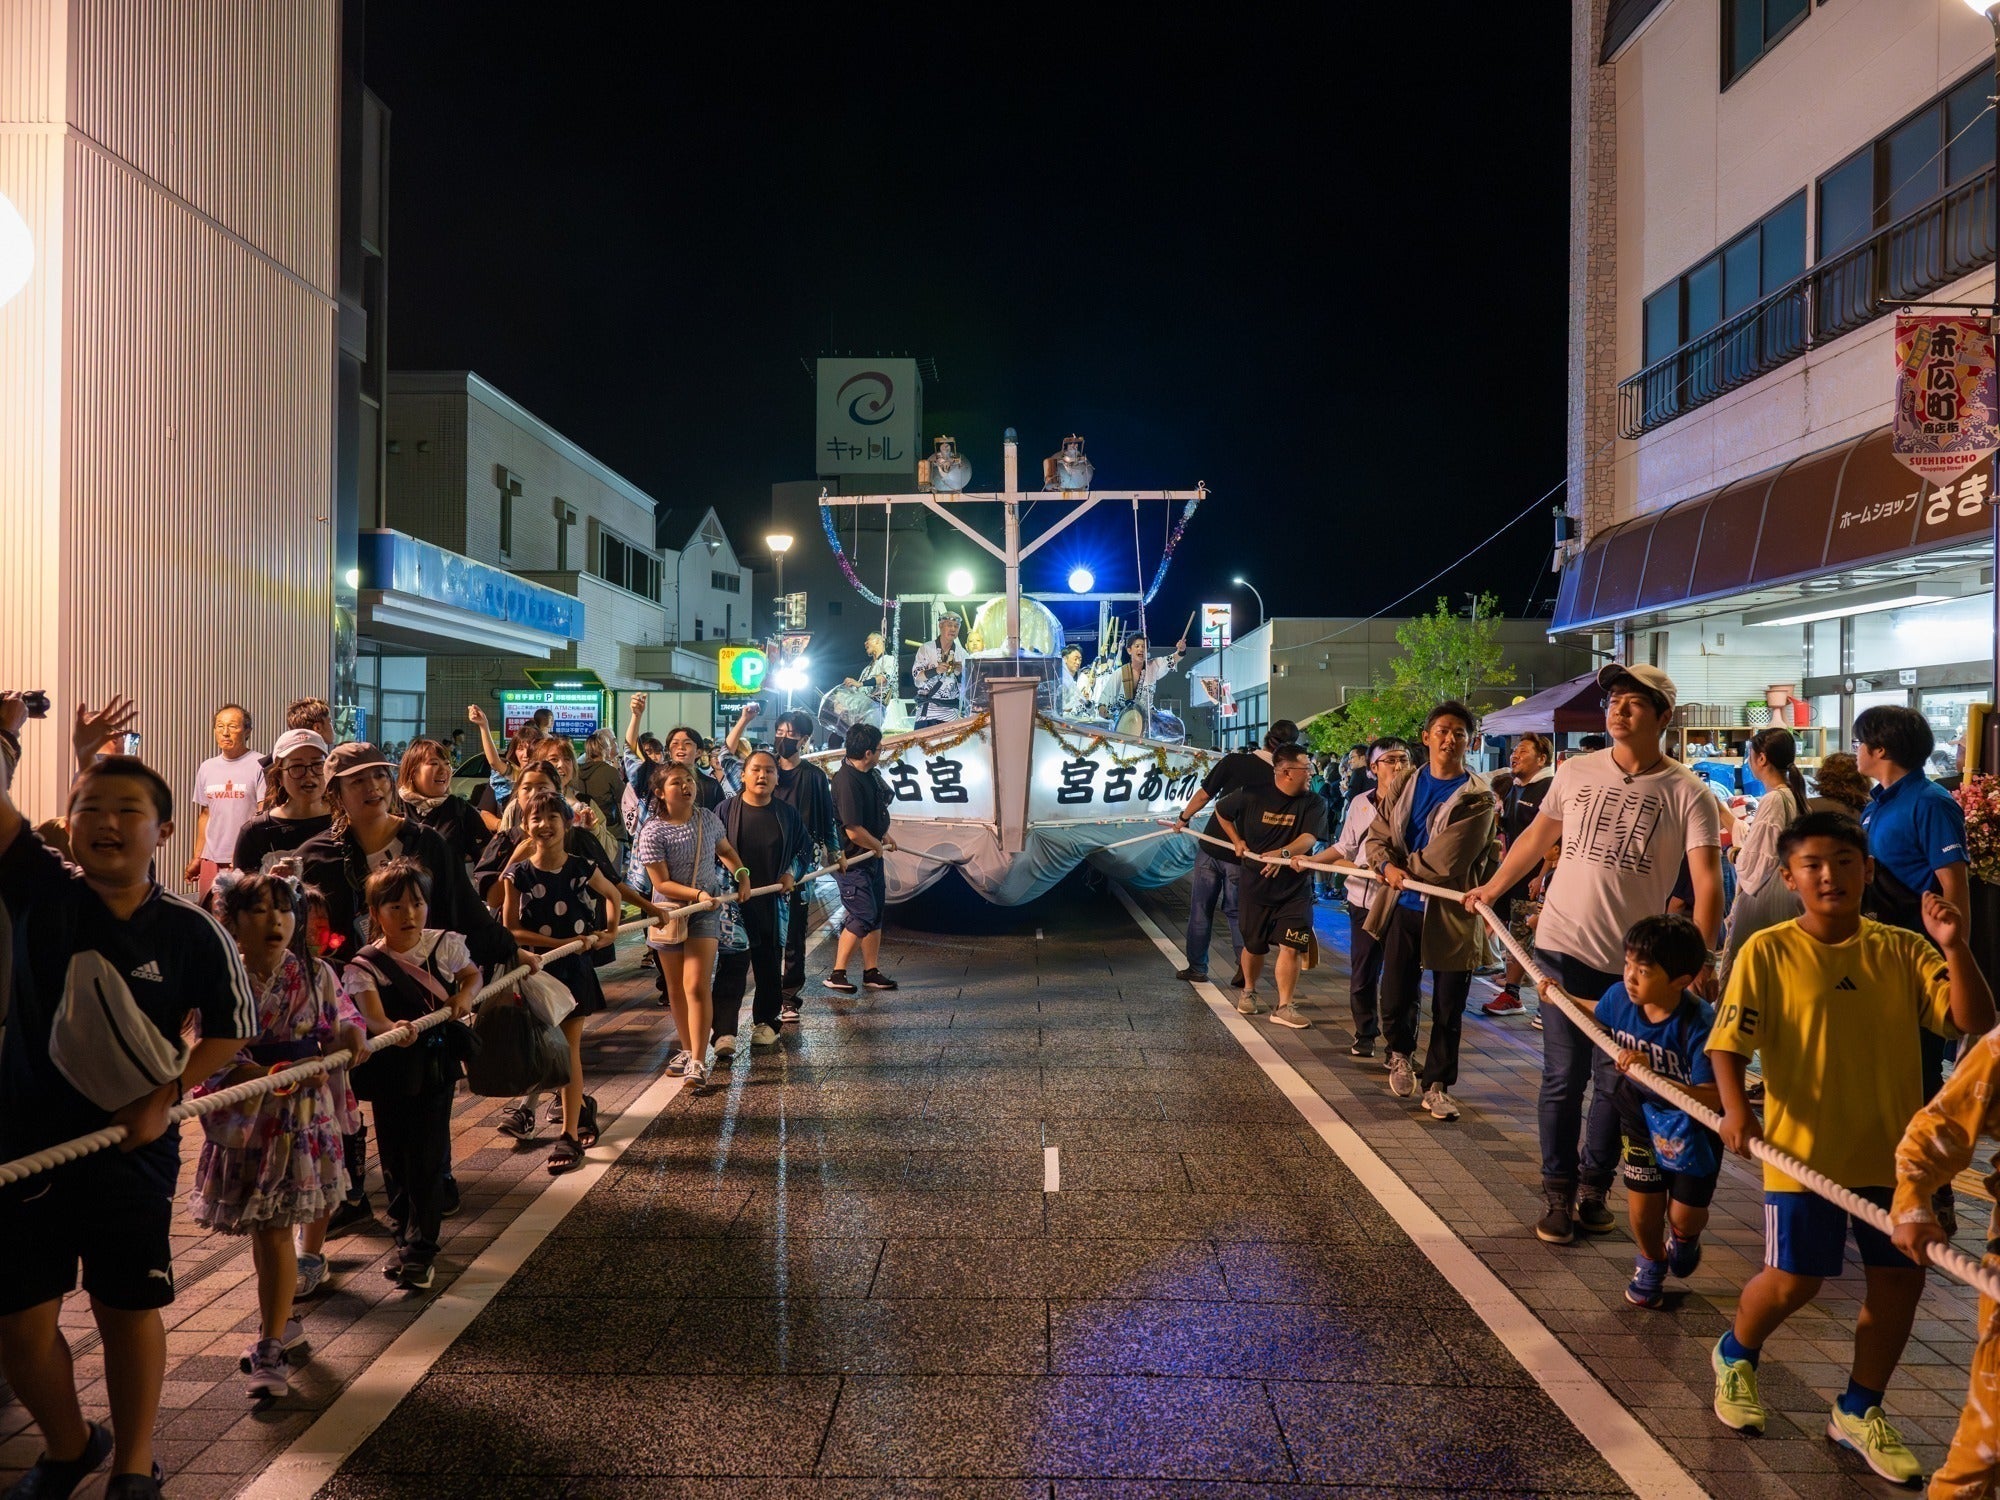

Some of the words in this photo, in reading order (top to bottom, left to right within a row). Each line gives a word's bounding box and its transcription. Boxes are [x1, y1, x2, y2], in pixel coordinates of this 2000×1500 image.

[1926, 325, 1957, 421] 末広町
[827, 436, 903, 461] キャトル
[1909, 454, 1977, 466] SUEHIROCHO
[214, 791, 245, 799] WALES
[131, 970, 164, 982] adidas
